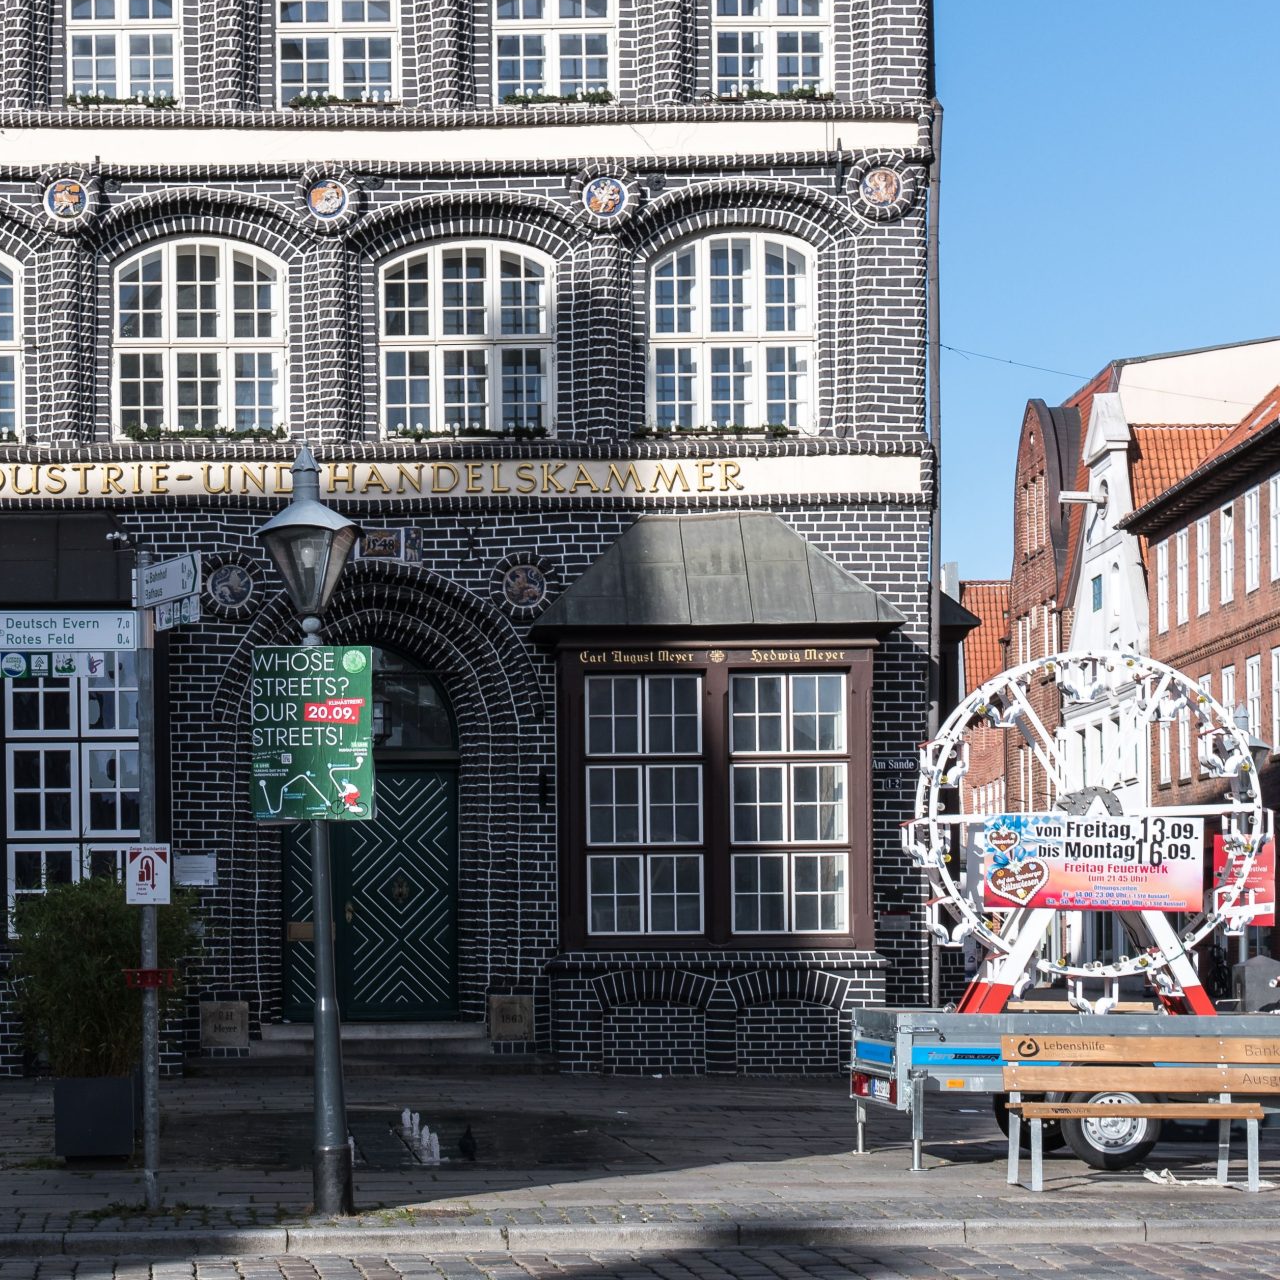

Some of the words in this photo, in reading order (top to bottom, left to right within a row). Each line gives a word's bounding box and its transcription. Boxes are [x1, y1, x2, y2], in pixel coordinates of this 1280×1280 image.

[326, 460, 745, 495] HANDELSKAMMER
[6, 617, 57, 630] Deutsch
[63, 618, 99, 630] Evern
[6, 633, 41, 645] Rotes
[47, 633, 75, 645] Feld
[252, 652, 335, 672] WHOSE
[580, 651, 607, 663] Carl
[612, 650, 654, 664] August
[658, 650, 694, 665] Meyer
[750, 649, 801, 663] Hedwig
[804, 648, 846, 662] Meyer
[253, 676, 349, 697] STREETS?
[253, 702, 297, 722] OUR
[308, 705, 356, 720] 20.09.
[252, 726, 343, 747] STREETS!
[872, 759, 886, 769] Am
[888, 759, 915, 769] Sande
[887, 778, 900, 788] 1-2
[1036, 825, 1061, 838] von
[1066, 821, 1136, 841] Freitag,
[1038, 844, 1060, 858] bis
[1065, 841, 1135, 862] Montag
[1064, 863, 1104, 875] Freitag
[1107, 863, 1168, 874] Feuerwerk
[1043, 1041, 1105, 1051] Lebenshilfe
[1242, 1073, 1280, 1087] Ausg
